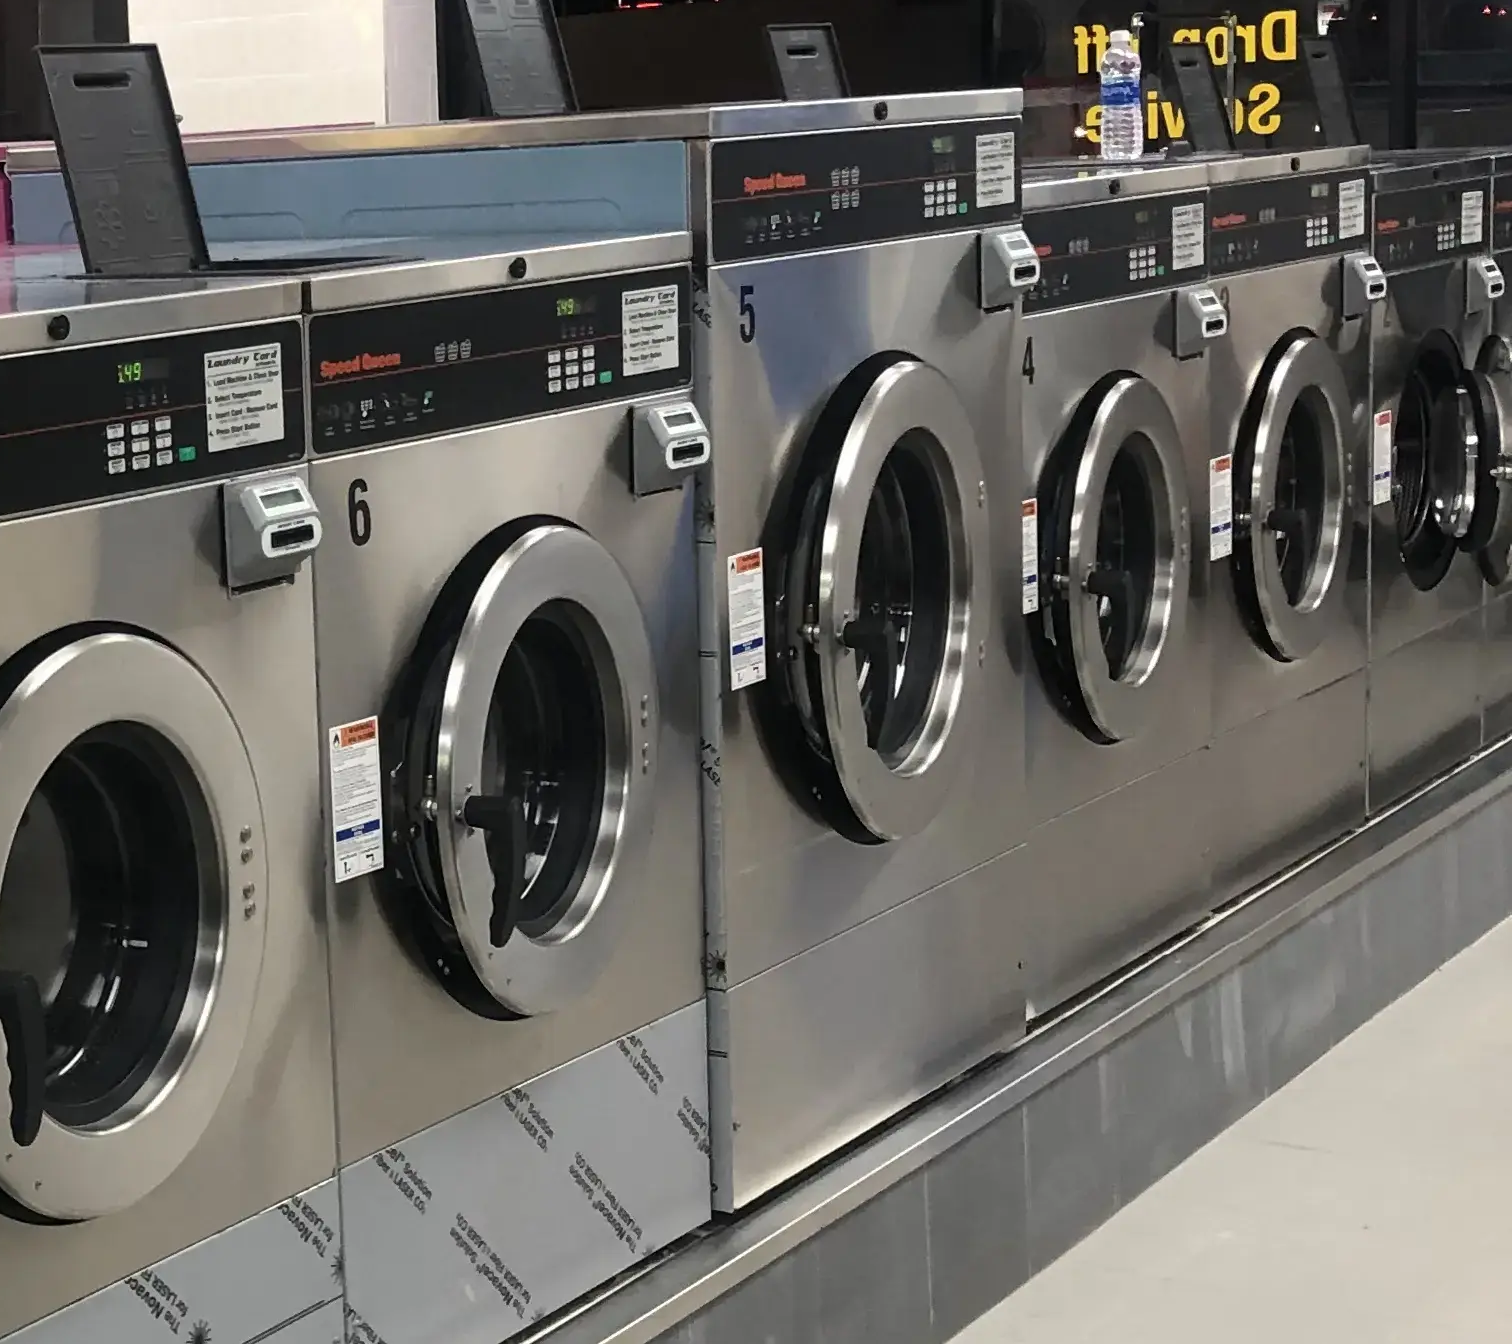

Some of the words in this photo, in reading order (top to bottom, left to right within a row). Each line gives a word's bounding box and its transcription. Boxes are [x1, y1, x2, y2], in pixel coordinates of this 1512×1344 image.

[740, 286, 755, 343] 5
[208, 356, 249, 368] Laundry
[254, 350, 277, 361] Card
[1023, 337, 1035, 384] 4
[348, 478, 371, 546] 6
